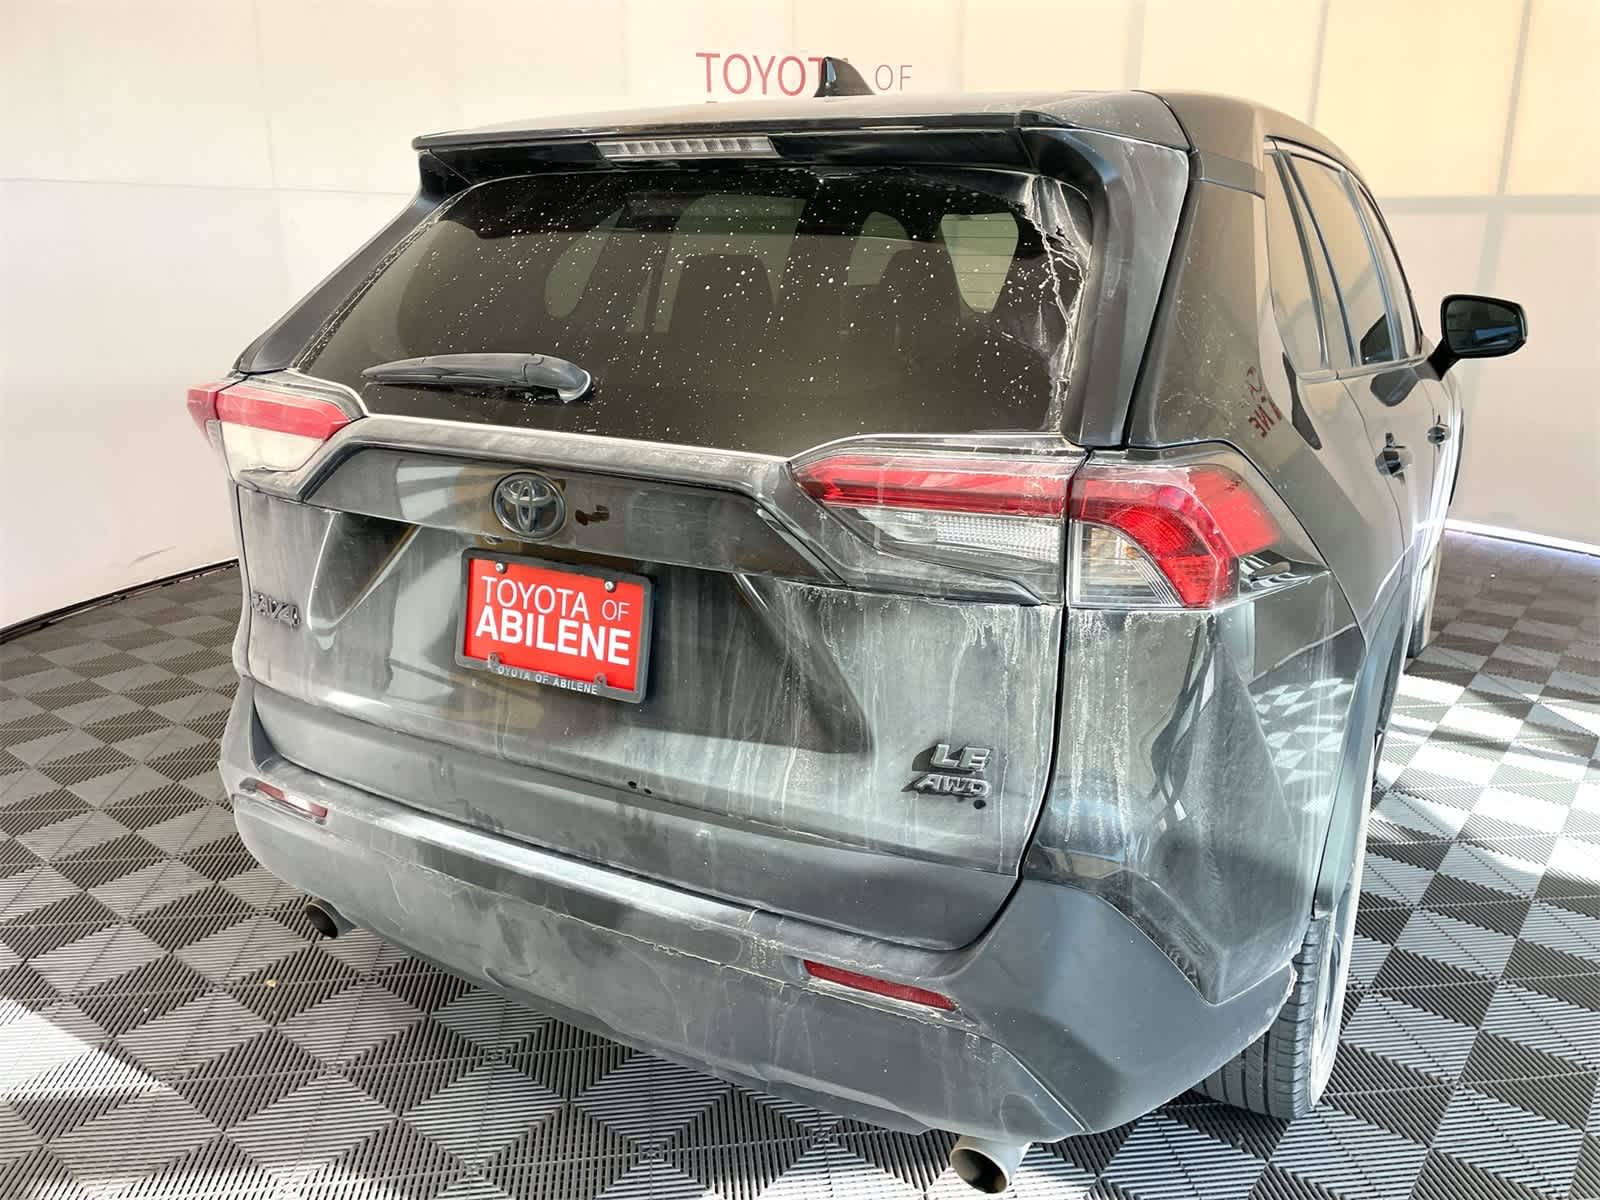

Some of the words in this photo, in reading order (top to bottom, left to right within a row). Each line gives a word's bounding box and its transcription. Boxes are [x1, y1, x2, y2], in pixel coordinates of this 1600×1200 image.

[695, 52, 848, 97] TOYOT
[875, 64, 912, 91] OF
[480, 575, 589, 621] TOYOTA
[601, 599, 631, 622] OF
[474, 605, 632, 666] ABILENE
[490, 662, 530, 681] OYOTA
[535, 673, 549, 684] OF
[553, 678, 598, 695] ABILENE
[930, 743, 992, 770] LE
[913, 773, 992, 797] AWD
